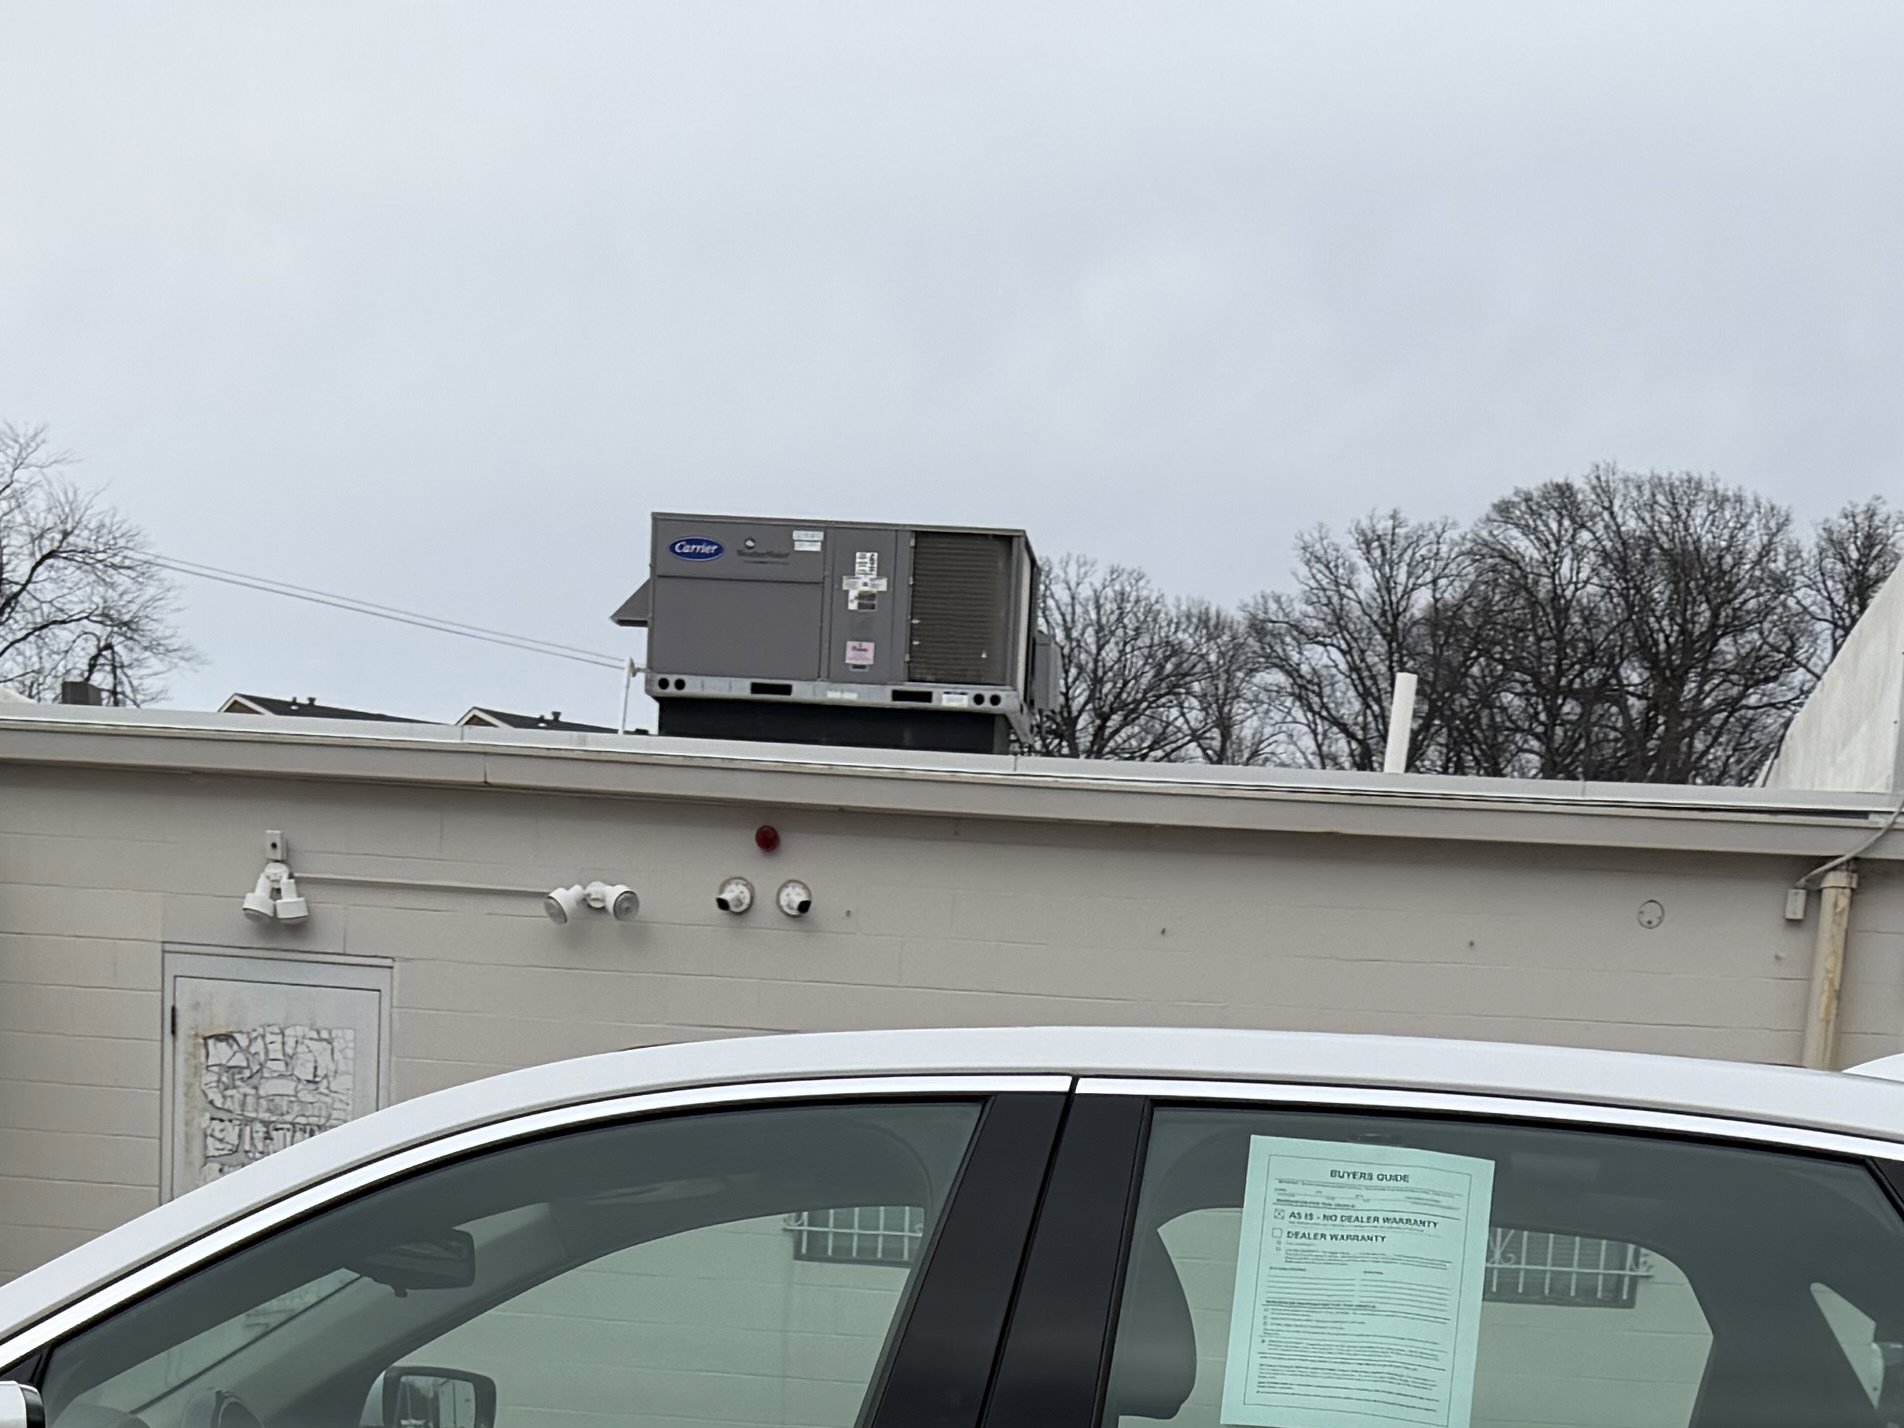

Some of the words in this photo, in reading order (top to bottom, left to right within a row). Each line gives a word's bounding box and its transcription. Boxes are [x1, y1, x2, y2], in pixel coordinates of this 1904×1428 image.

[675, 541, 718, 554] Carrier
[1330, 1169, 1373, 1181] BUYERS
[1376, 1173, 1410, 1183] GUIDE
[1288, 1211, 1302, 1220] AS
[1304, 1212, 1314, 1221] IS
[1322, 1213, 1338, 1223] NO
[1340, 1214, 1380, 1224] DEALER
[1382, 1215, 1439, 1229] WARRANTY
[1286, 1230, 1327, 1241] DEALER
[1329, 1233, 1387, 1243] WARRANTY
